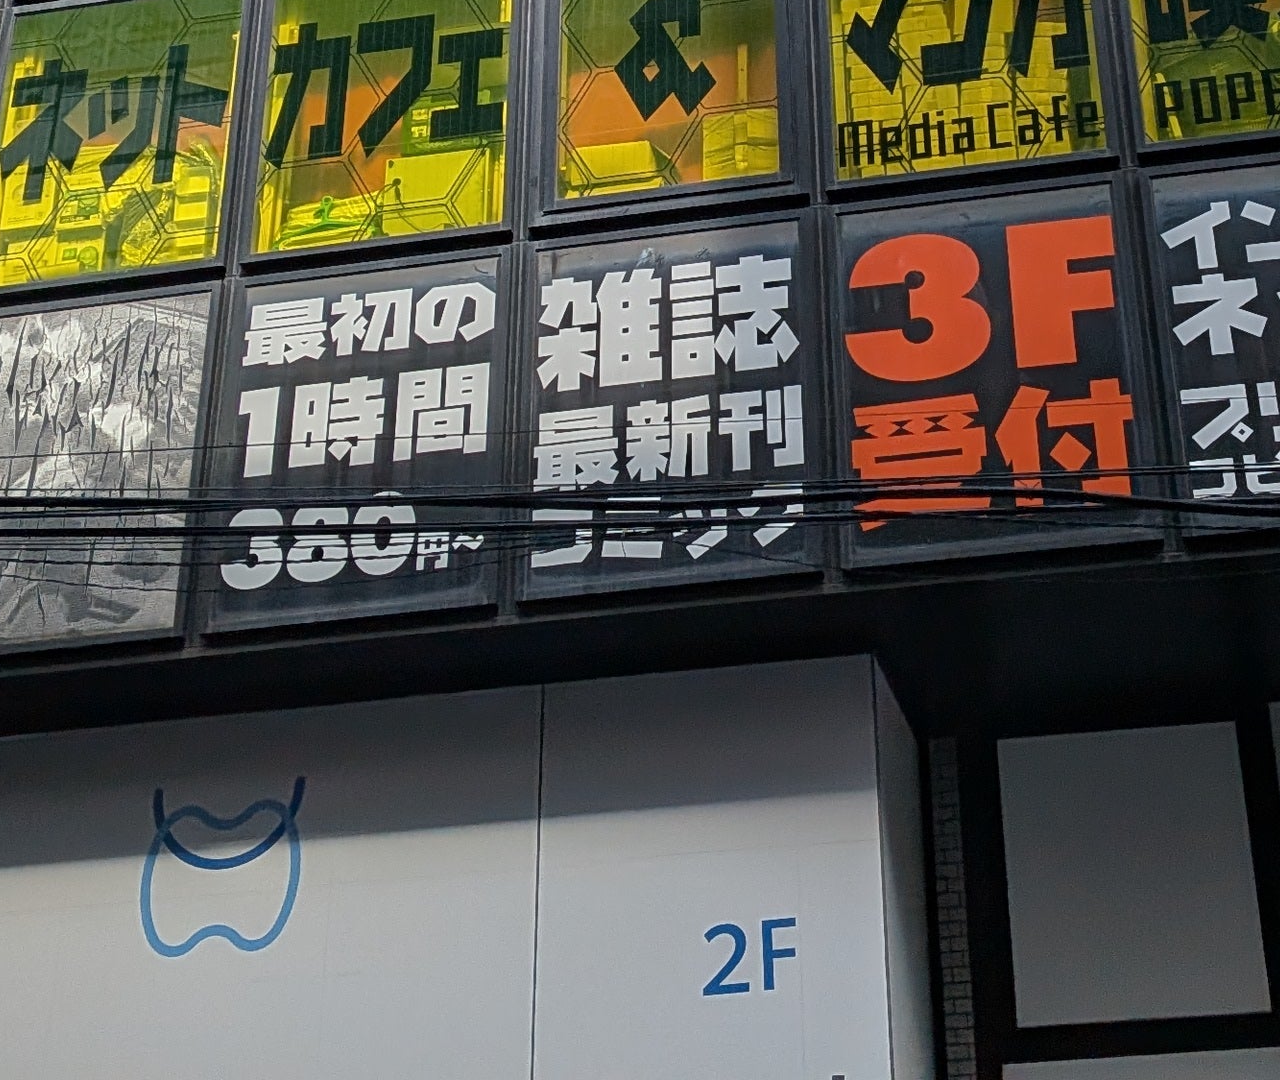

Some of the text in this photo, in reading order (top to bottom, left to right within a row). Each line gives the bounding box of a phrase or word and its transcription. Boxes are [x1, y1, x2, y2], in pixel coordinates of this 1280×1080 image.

[838, 115, 975, 168] Media
[987, 95, 1100, 149] Cafe
[242, 281, 496, 366] 最初の
[537, 254, 800, 393] 雑誌
[845, 215, 1116, 382] 3F
[239, 362, 491, 479] 1時間
[533, 385, 804, 492] 最新刊
[851, 377, 1134, 532] 受付
[703, 917, 797, 997] 2F
